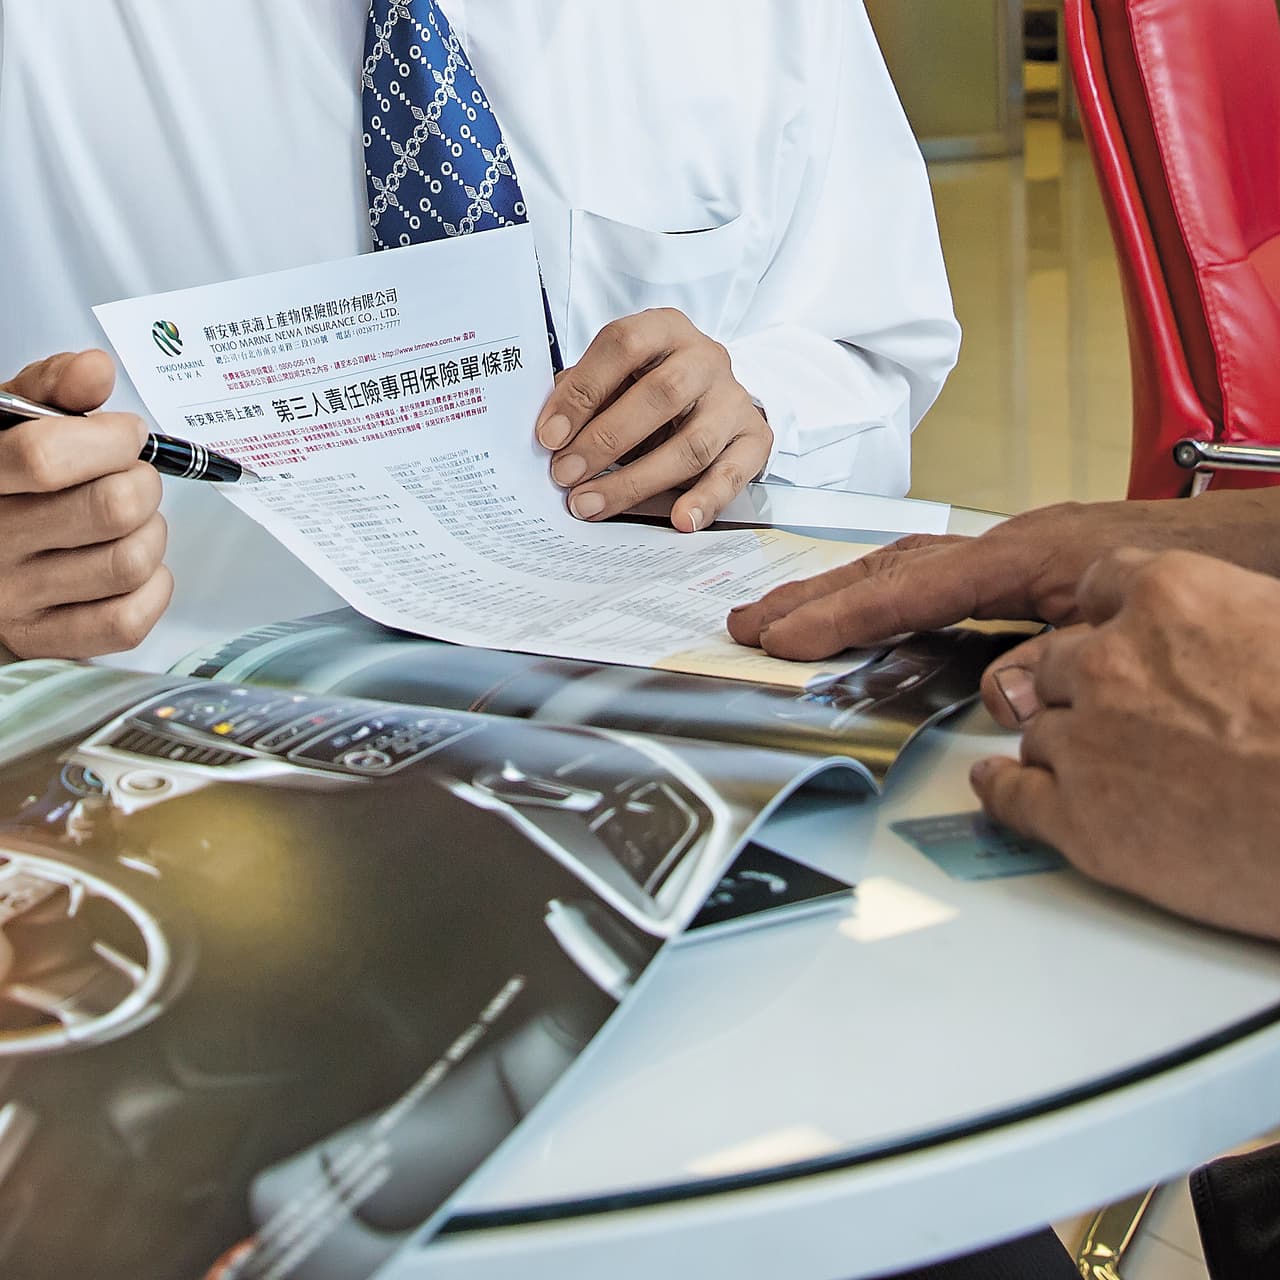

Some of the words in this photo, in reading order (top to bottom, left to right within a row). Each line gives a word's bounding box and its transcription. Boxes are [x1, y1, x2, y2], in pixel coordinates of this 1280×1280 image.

[202, 288, 398, 342] 新安東京海上產物保險股份有限公司
[209, 339, 237, 354] TOKIO
[239, 332, 273, 348] MARINE
[275, 327, 302, 342] NEWA
[304, 316, 356, 336] INSURANCE
[380, 306, 400, 320] LTD.
[271, 346, 523, 424] 第三人責任險專用保險單條款
[184, 404, 265, 428] 新安東京海上產物
